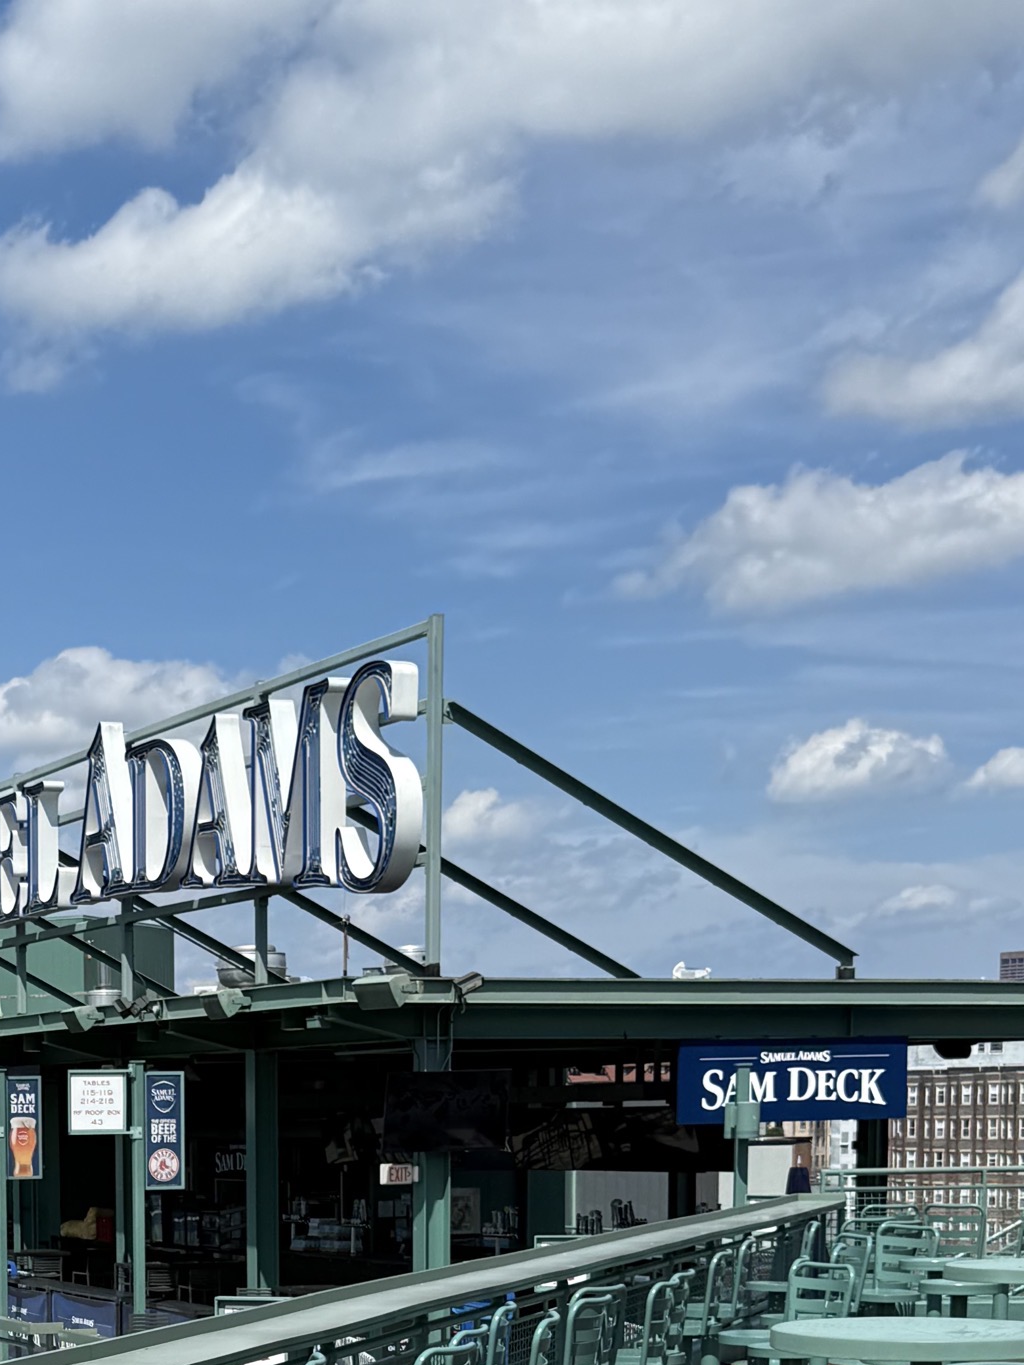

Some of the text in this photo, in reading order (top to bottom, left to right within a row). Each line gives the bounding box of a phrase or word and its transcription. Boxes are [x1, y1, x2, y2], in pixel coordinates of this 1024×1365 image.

[71, 660, 423, 905] ADAMS
[760, 1050, 831, 1064] SAMUEL ADAMS
[787, 1067, 887, 1106] DECK
[10, 1093, 35, 1104] SAM
[10, 1104, 36, 1114] DECK
[151, 1123, 176, 1134] BEER
[151, 1134, 177, 1143] OF THE
[389, 1166, 408, 1182] EXIT
